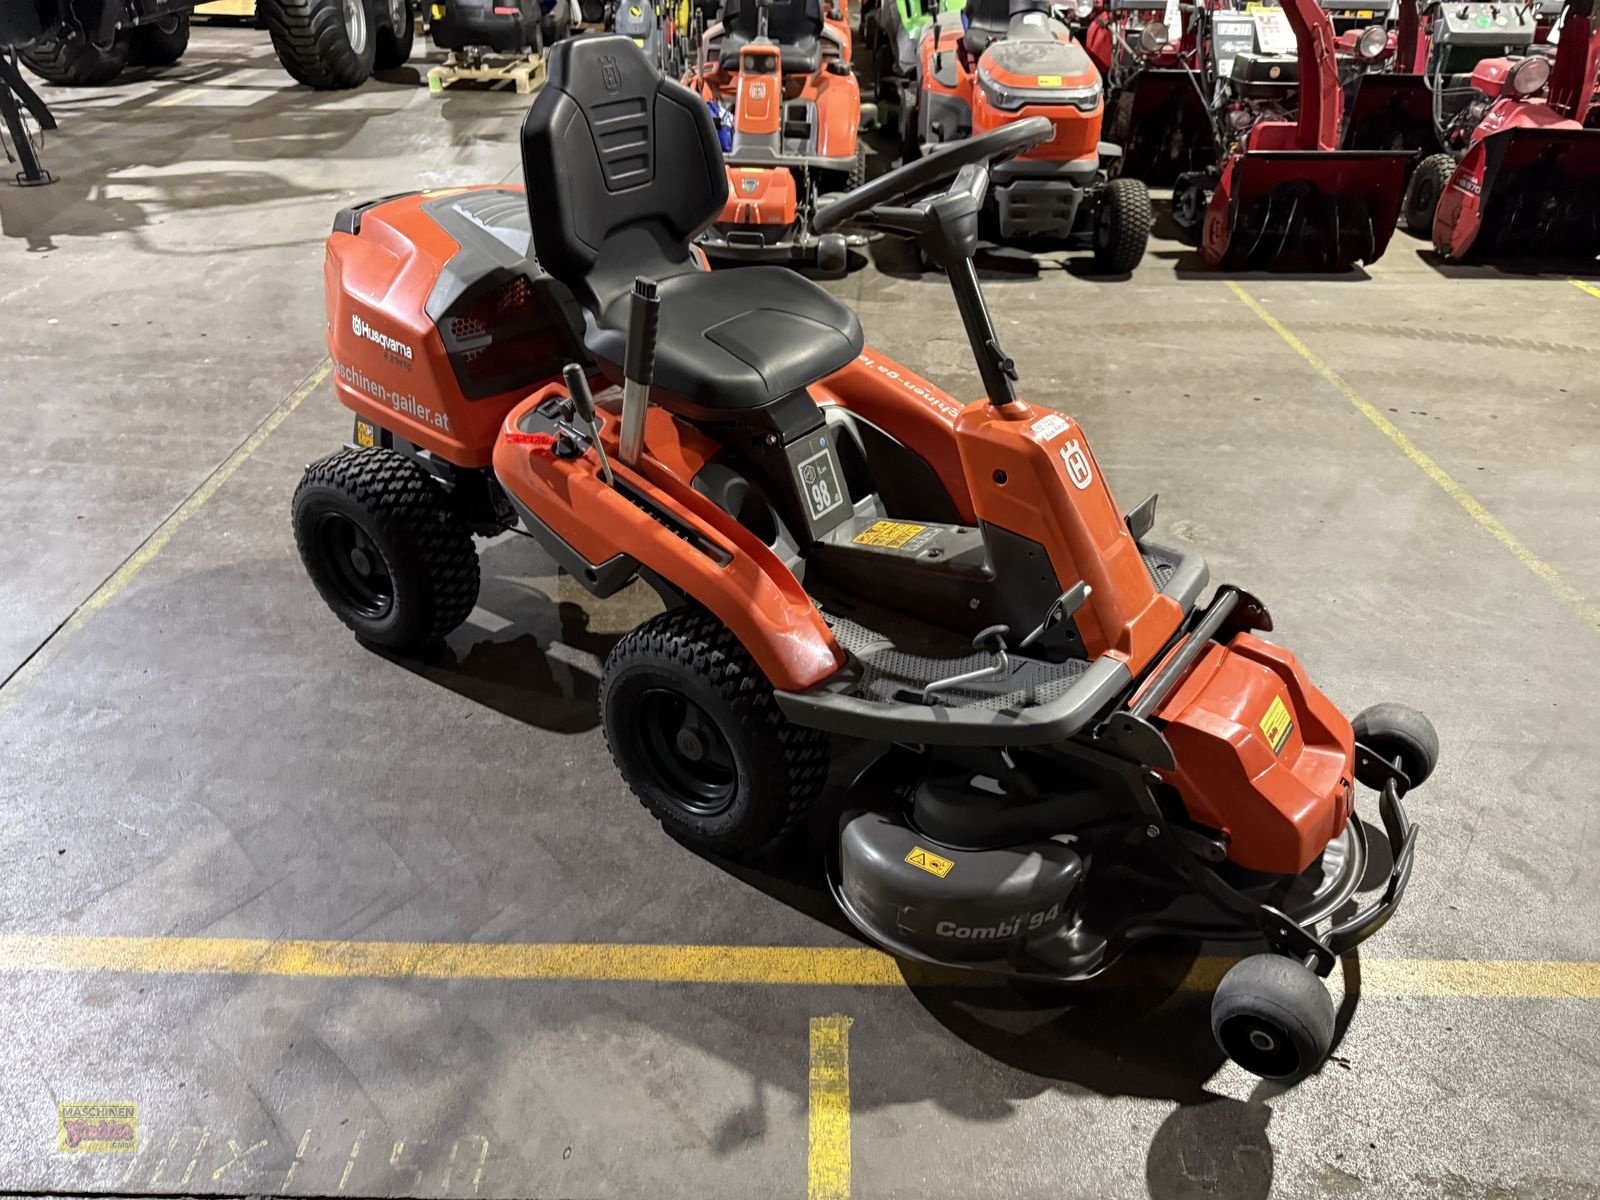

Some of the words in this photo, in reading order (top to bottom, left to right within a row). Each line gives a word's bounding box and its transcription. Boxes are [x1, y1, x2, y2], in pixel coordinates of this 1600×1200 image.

[361, 321, 413, 359] Husqvarna
[811, 480, 832, 512] 98
[935, 915, 1022, 939] Combi
[1027, 902, 1060, 930] 94
